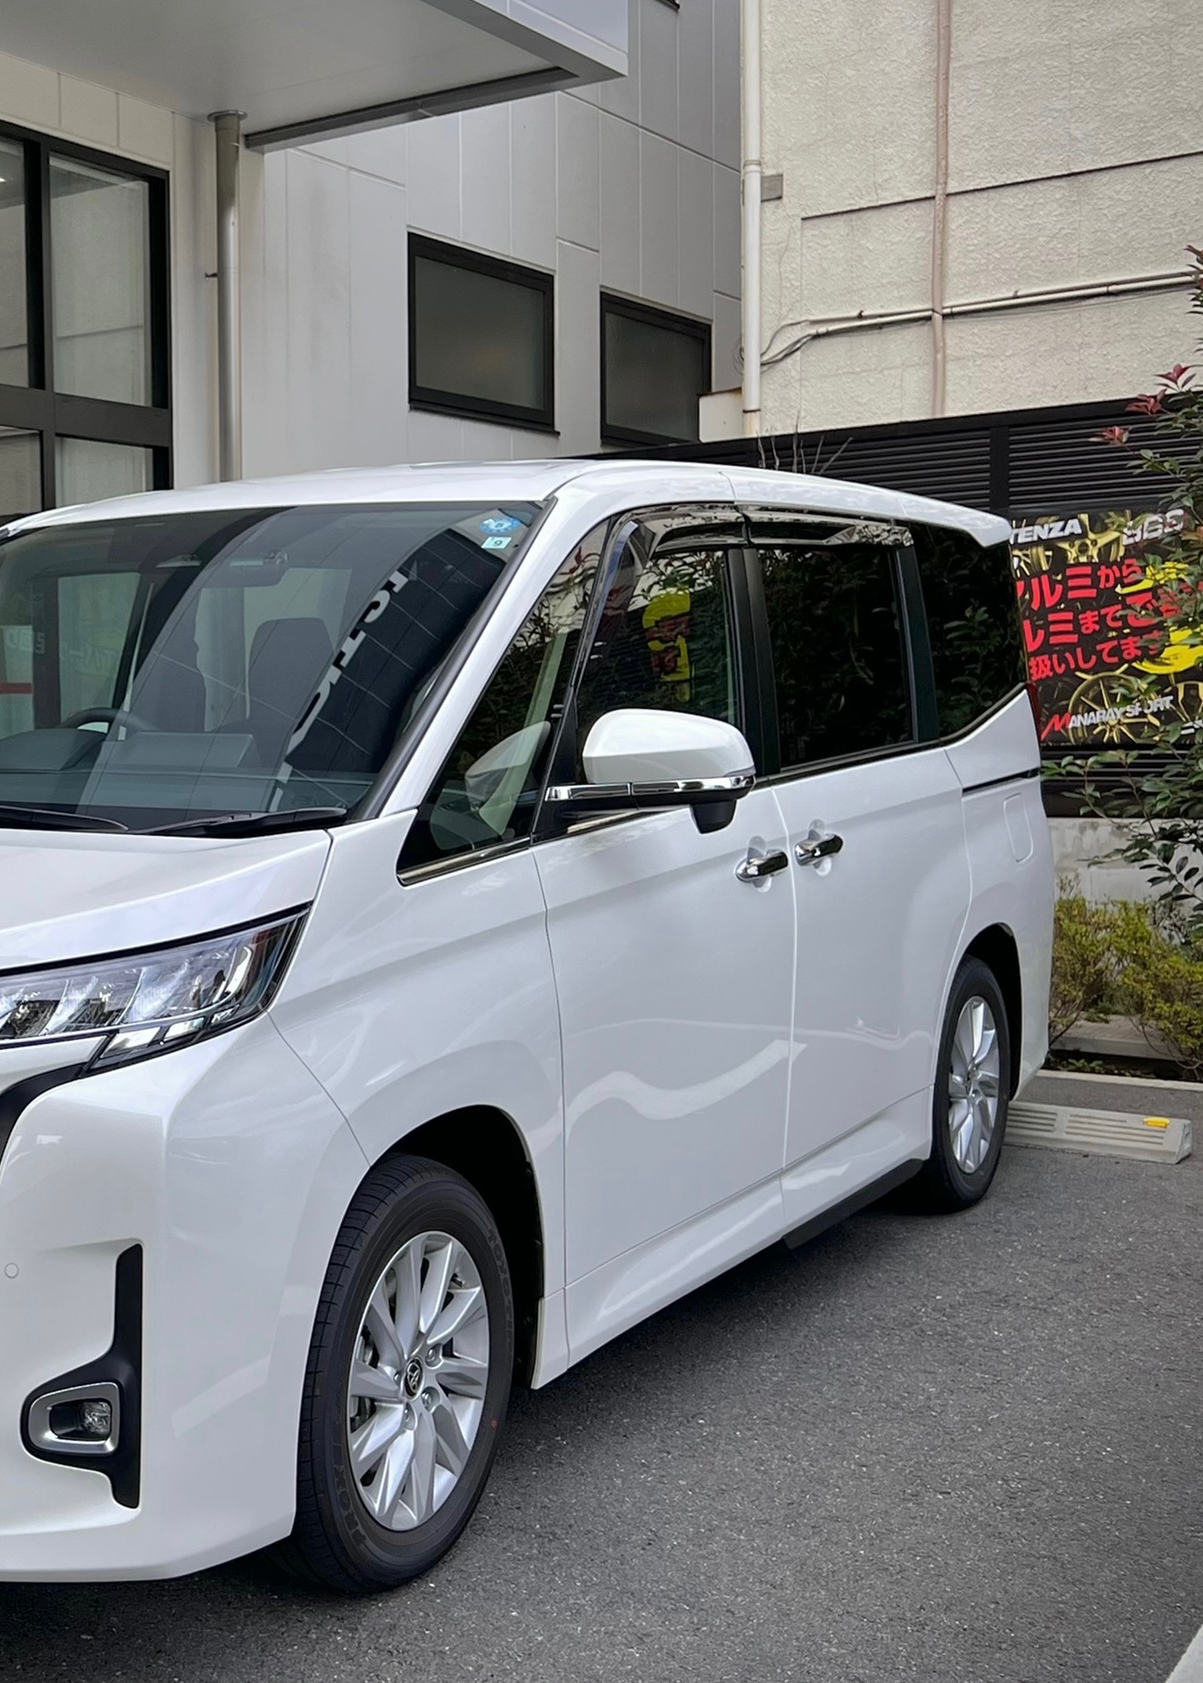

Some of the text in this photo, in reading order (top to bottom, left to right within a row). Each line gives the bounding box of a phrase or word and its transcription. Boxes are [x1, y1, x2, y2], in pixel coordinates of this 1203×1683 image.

[1016, 558, 1143, 612] ルミから
[1041, 707, 1125, 741] MANARAY
